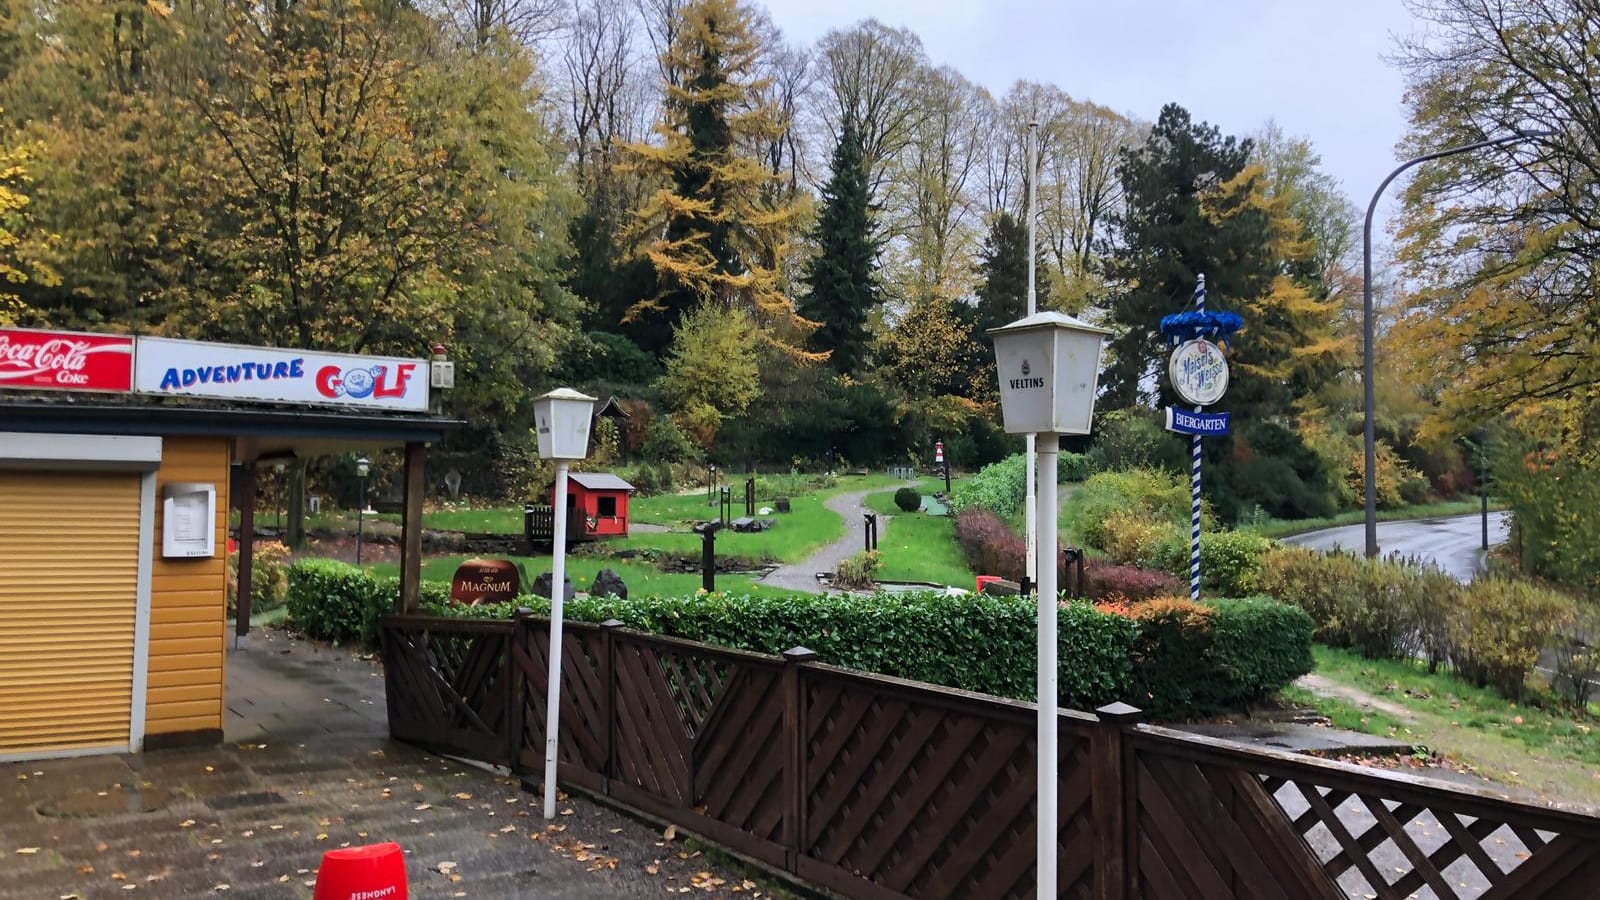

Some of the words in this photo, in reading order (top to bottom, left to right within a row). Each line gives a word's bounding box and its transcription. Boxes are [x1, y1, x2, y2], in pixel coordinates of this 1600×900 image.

[160, 358, 304, 390] ADVENTURE
[315, 364, 416, 399] GOLF
[1010, 377, 1044, 389] VELTINS
[1176, 412, 1226, 430] BIERGARTEN
[461, 581, 511, 592] MAGNUM
[351, 885, 396, 900] LANGNESE
